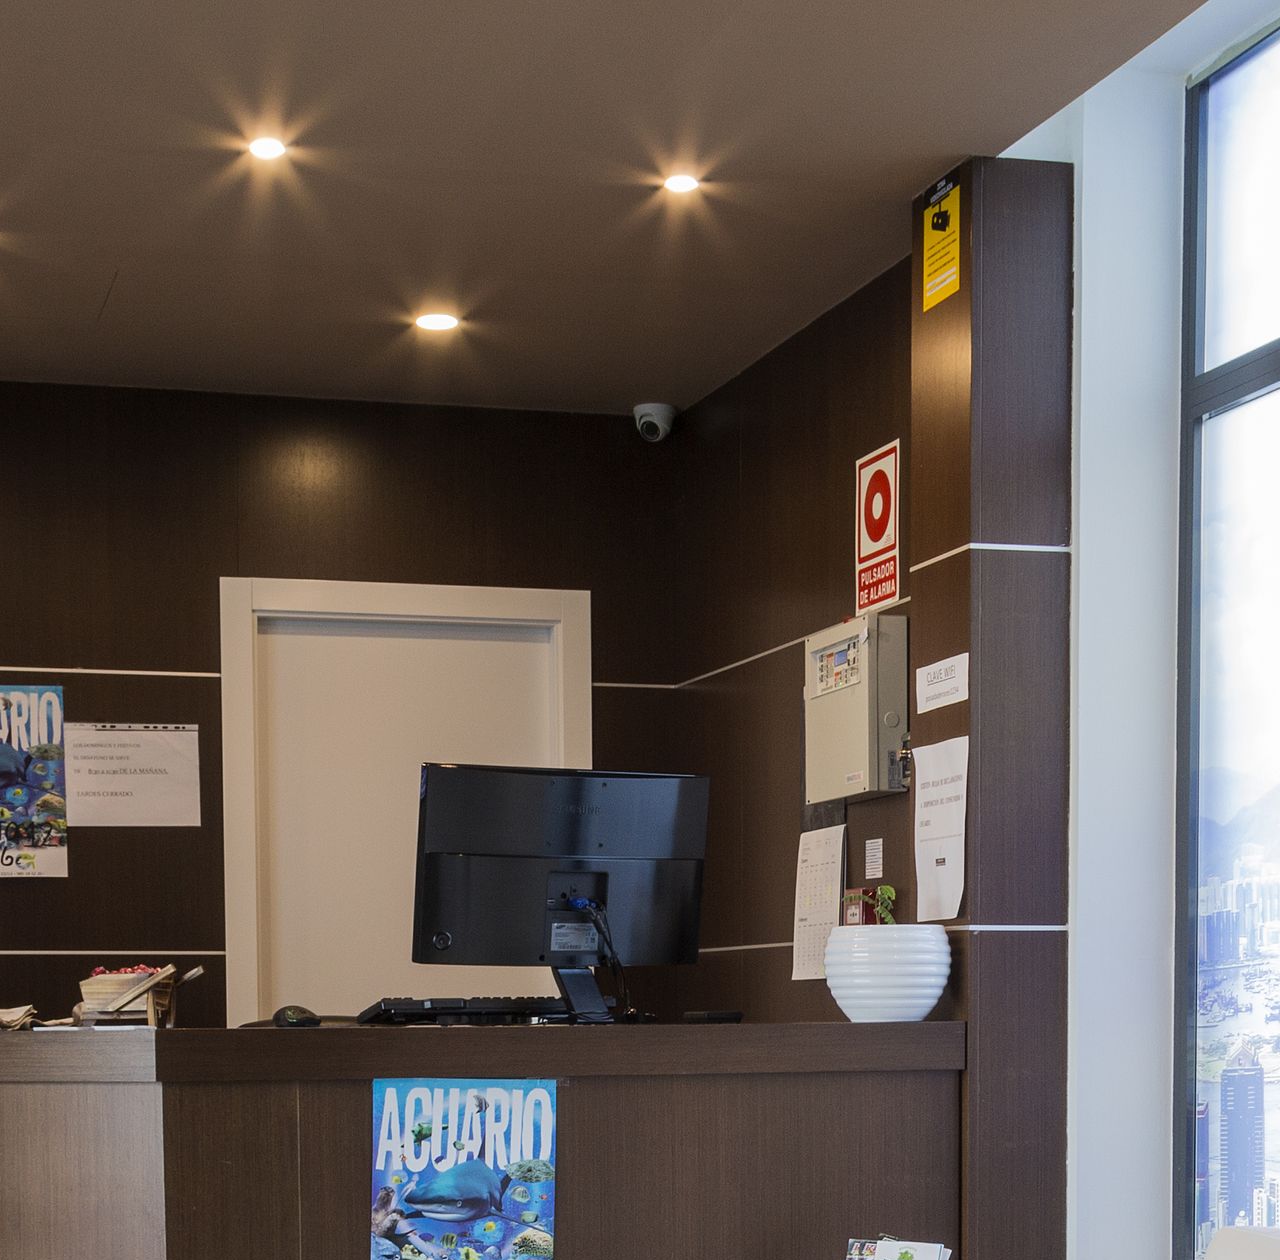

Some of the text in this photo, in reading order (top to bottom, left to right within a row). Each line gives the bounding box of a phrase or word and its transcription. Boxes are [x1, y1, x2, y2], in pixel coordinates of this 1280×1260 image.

[861, 561, 895, 587] PULSADOR
[860, 579, 896, 605] DE ALARMA
[927, 669, 943, 683] CLAVE
[375, 1087, 554, 1173] ACUARIO
